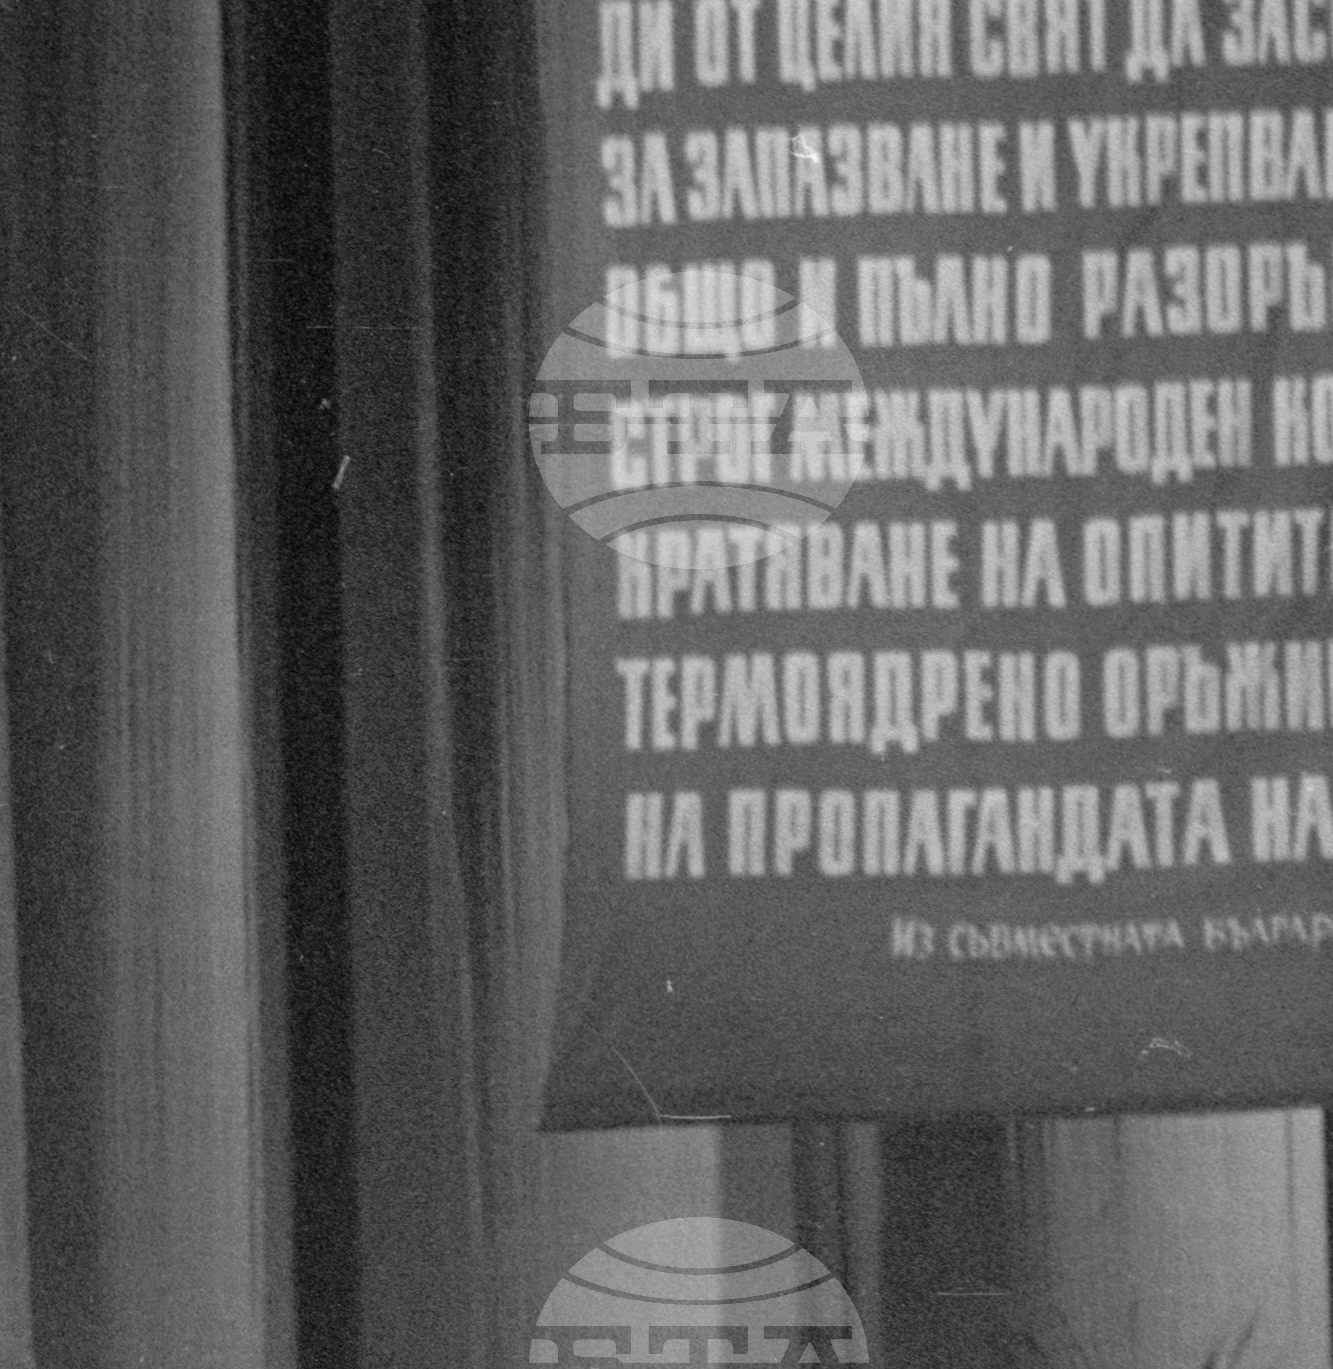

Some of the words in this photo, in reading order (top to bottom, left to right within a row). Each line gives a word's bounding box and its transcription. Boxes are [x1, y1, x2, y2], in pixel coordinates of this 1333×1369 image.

[693, 0, 756, 86] ОТ
[1125, 0, 1206, 84] ДА
[600, 131, 677, 229] ЗА
[684, 121, 1009, 222] ЗАПАЗВАНЕ
[1019, 119, 1057, 214] И
[1067, 107, 1333, 210] УКРЕПВА
[605, 259, 777, 362] ОБЩО
[799, 256, 837, 350] И
[857, 253, 1052, 347] ПЪЛНО
[1083, 241, 1327, 340] РАЗОРЪ
[789, 379, 1254, 491] МЕЖДУНАРОДЕН
[618, 519, 960, 620] КРАТЯВАНЕ
[982, 517, 1067, 609] НА
[1083, 506, 1333, 608] ОПИТИТ
[616, 649, 1083, 756] ТЕРМОЯДРЕНО
[1103, 640, 1333, 740] ОРЪЖИ
[625, 792, 706, 881] НА
[727, 777, 1232, 886] ПРОПАГАНДАТА
[1250, 770, 1333, 865] НА
[891, 917, 935, 959] ИЗ
